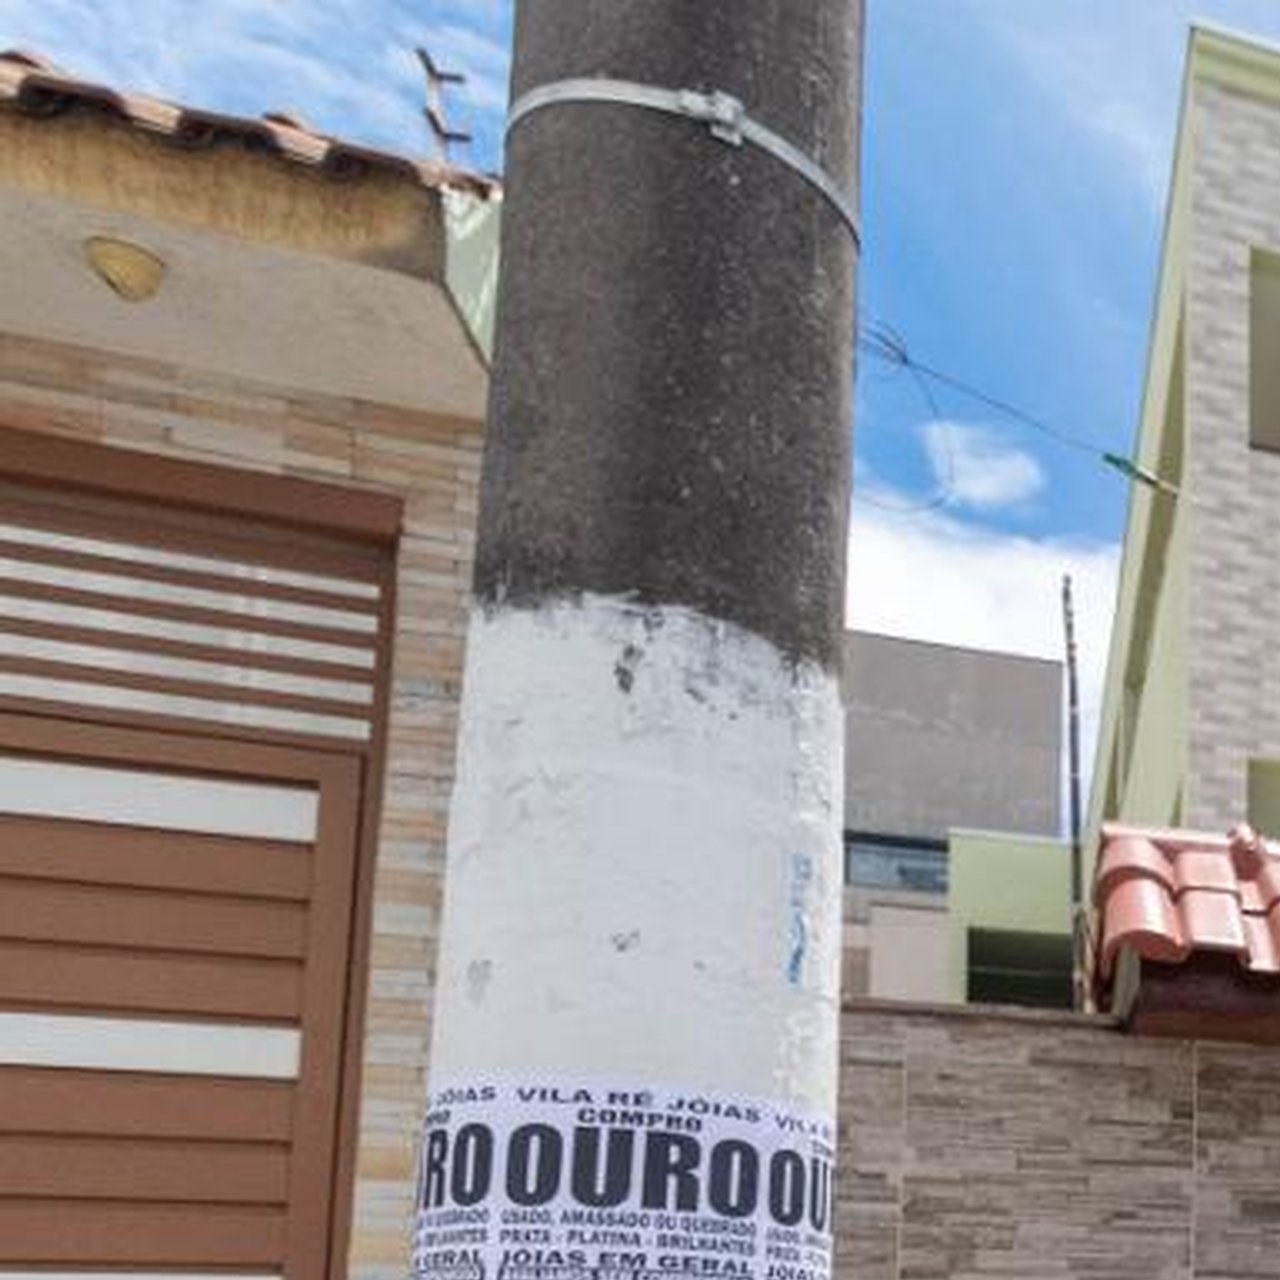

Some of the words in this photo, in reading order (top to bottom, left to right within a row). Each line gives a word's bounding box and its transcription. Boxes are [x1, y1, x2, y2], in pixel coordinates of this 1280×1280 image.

[516, 1087, 593, 1104] VILA
[577, 1108, 702, 1132] COMPRO
[505, 1122, 760, 1218] OURO
